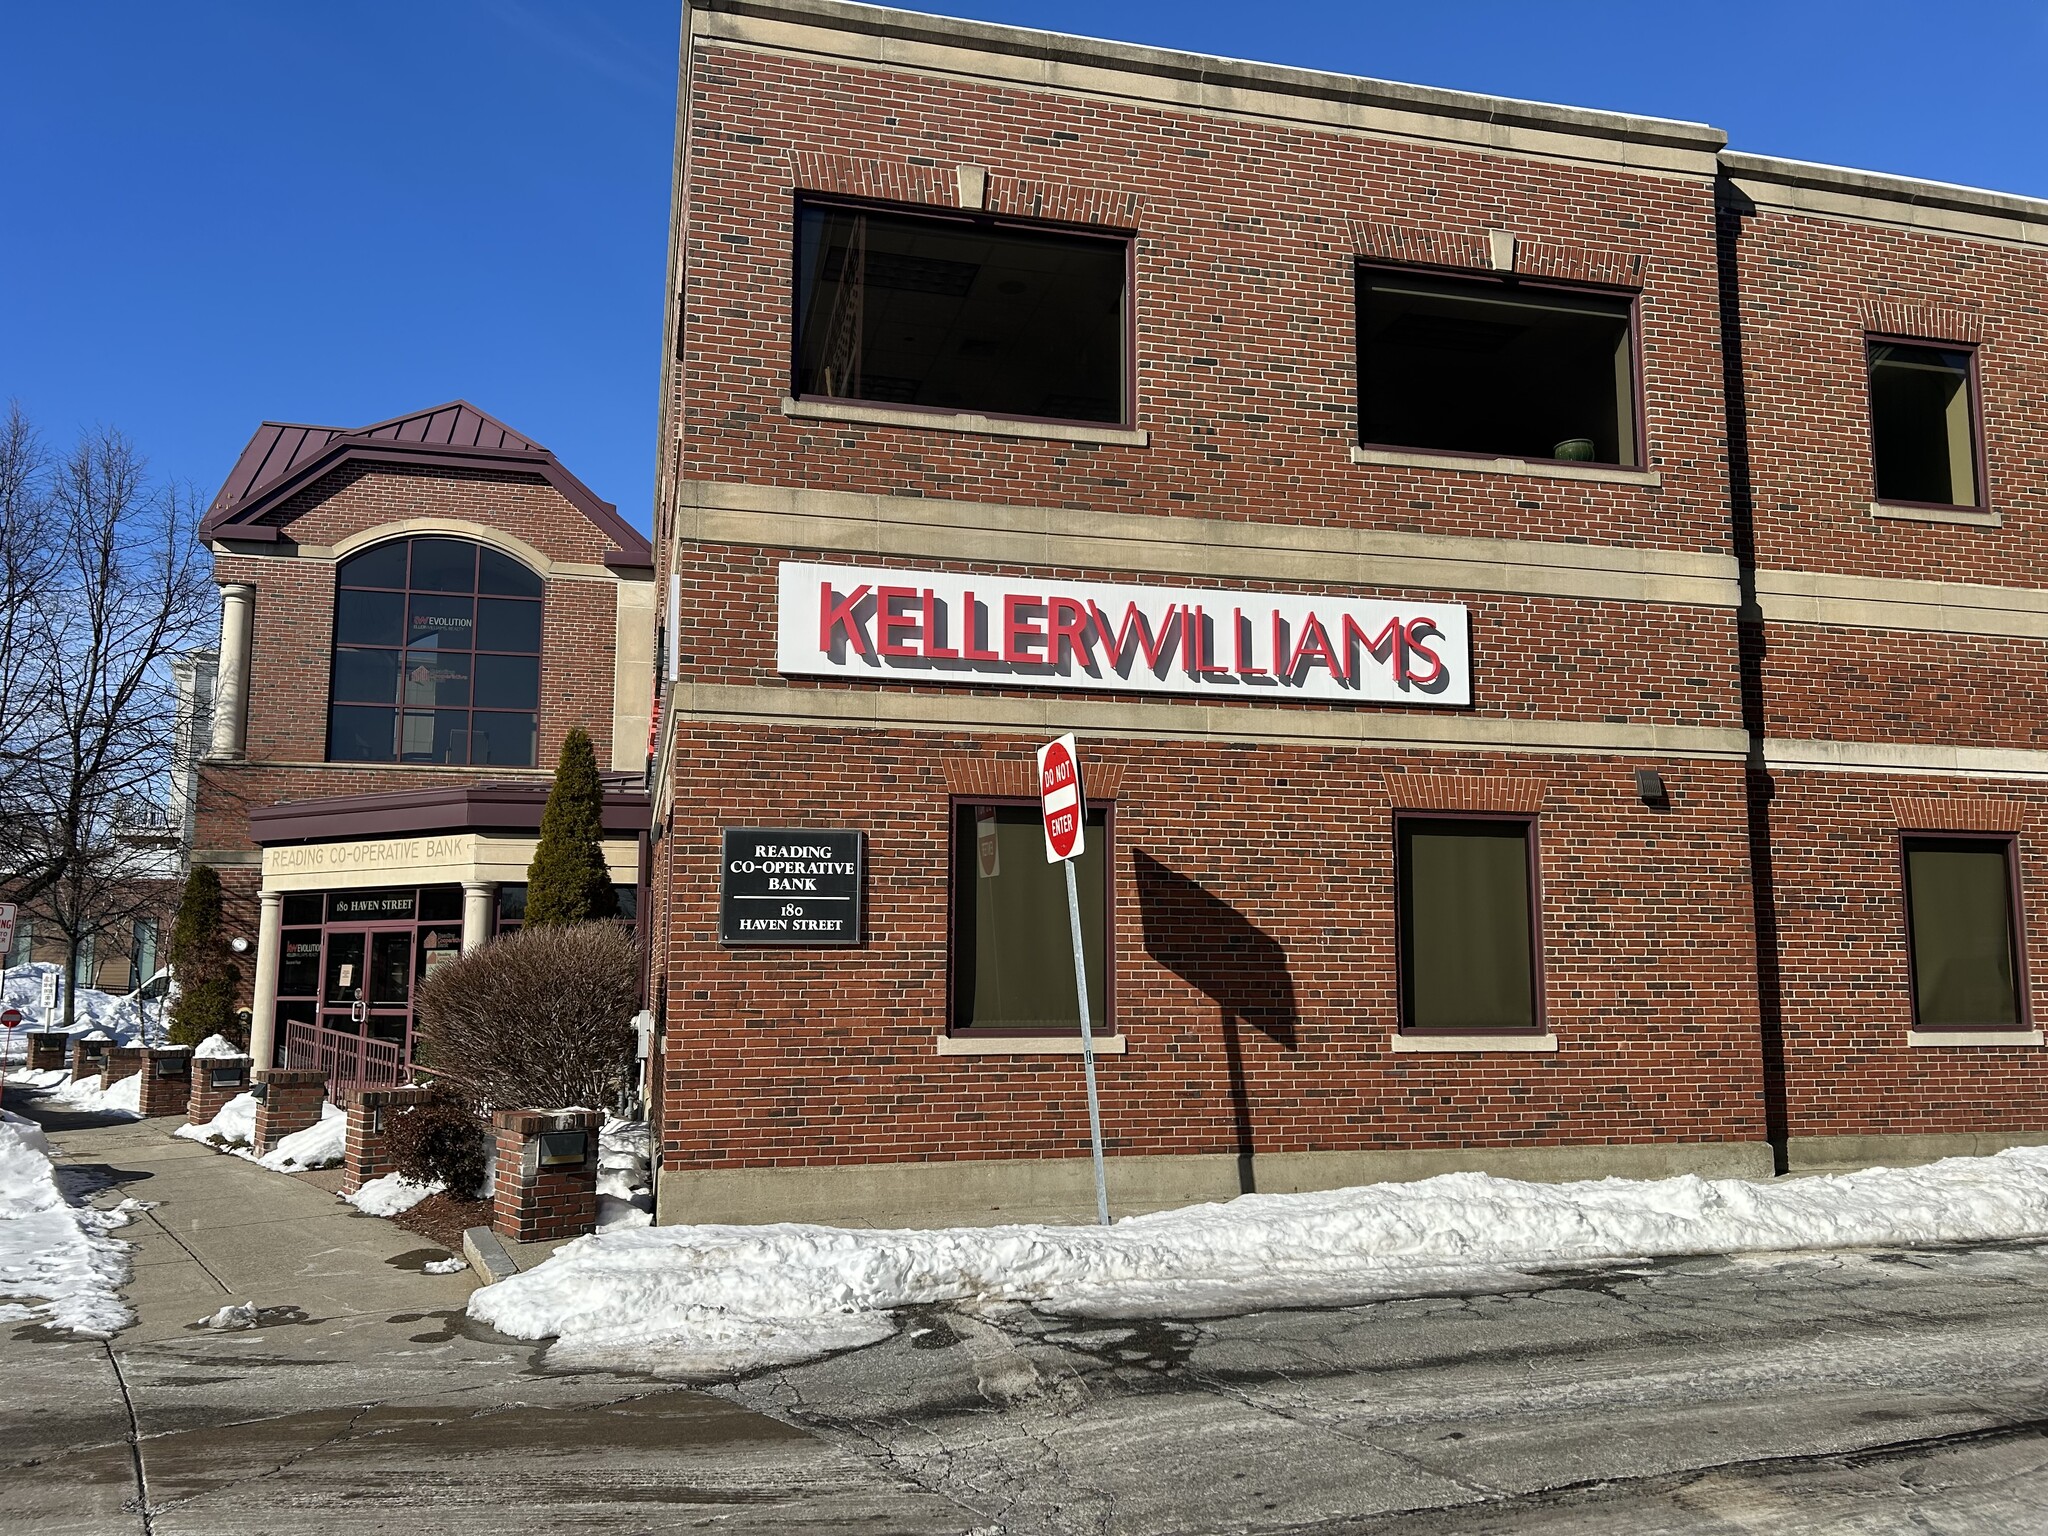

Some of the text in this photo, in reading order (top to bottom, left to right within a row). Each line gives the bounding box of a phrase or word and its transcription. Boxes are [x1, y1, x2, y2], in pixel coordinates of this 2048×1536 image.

[1044, 760, 1071, 788] DO NOT
[1051, 813, 1073, 837] ENTER
[272, 838, 463, 868] READING CO-OPERATIVE BANK
[754, 845, 832, 859] READING
[730, 860, 855, 875] CO-OPERATIVE
[768, 877, 817, 891] BANK
[336, 898, 413, 912] 180 HAVEN STREET
[780, 903, 803, 917] 180
[739, 919, 843, 931] HAVEN STREET
